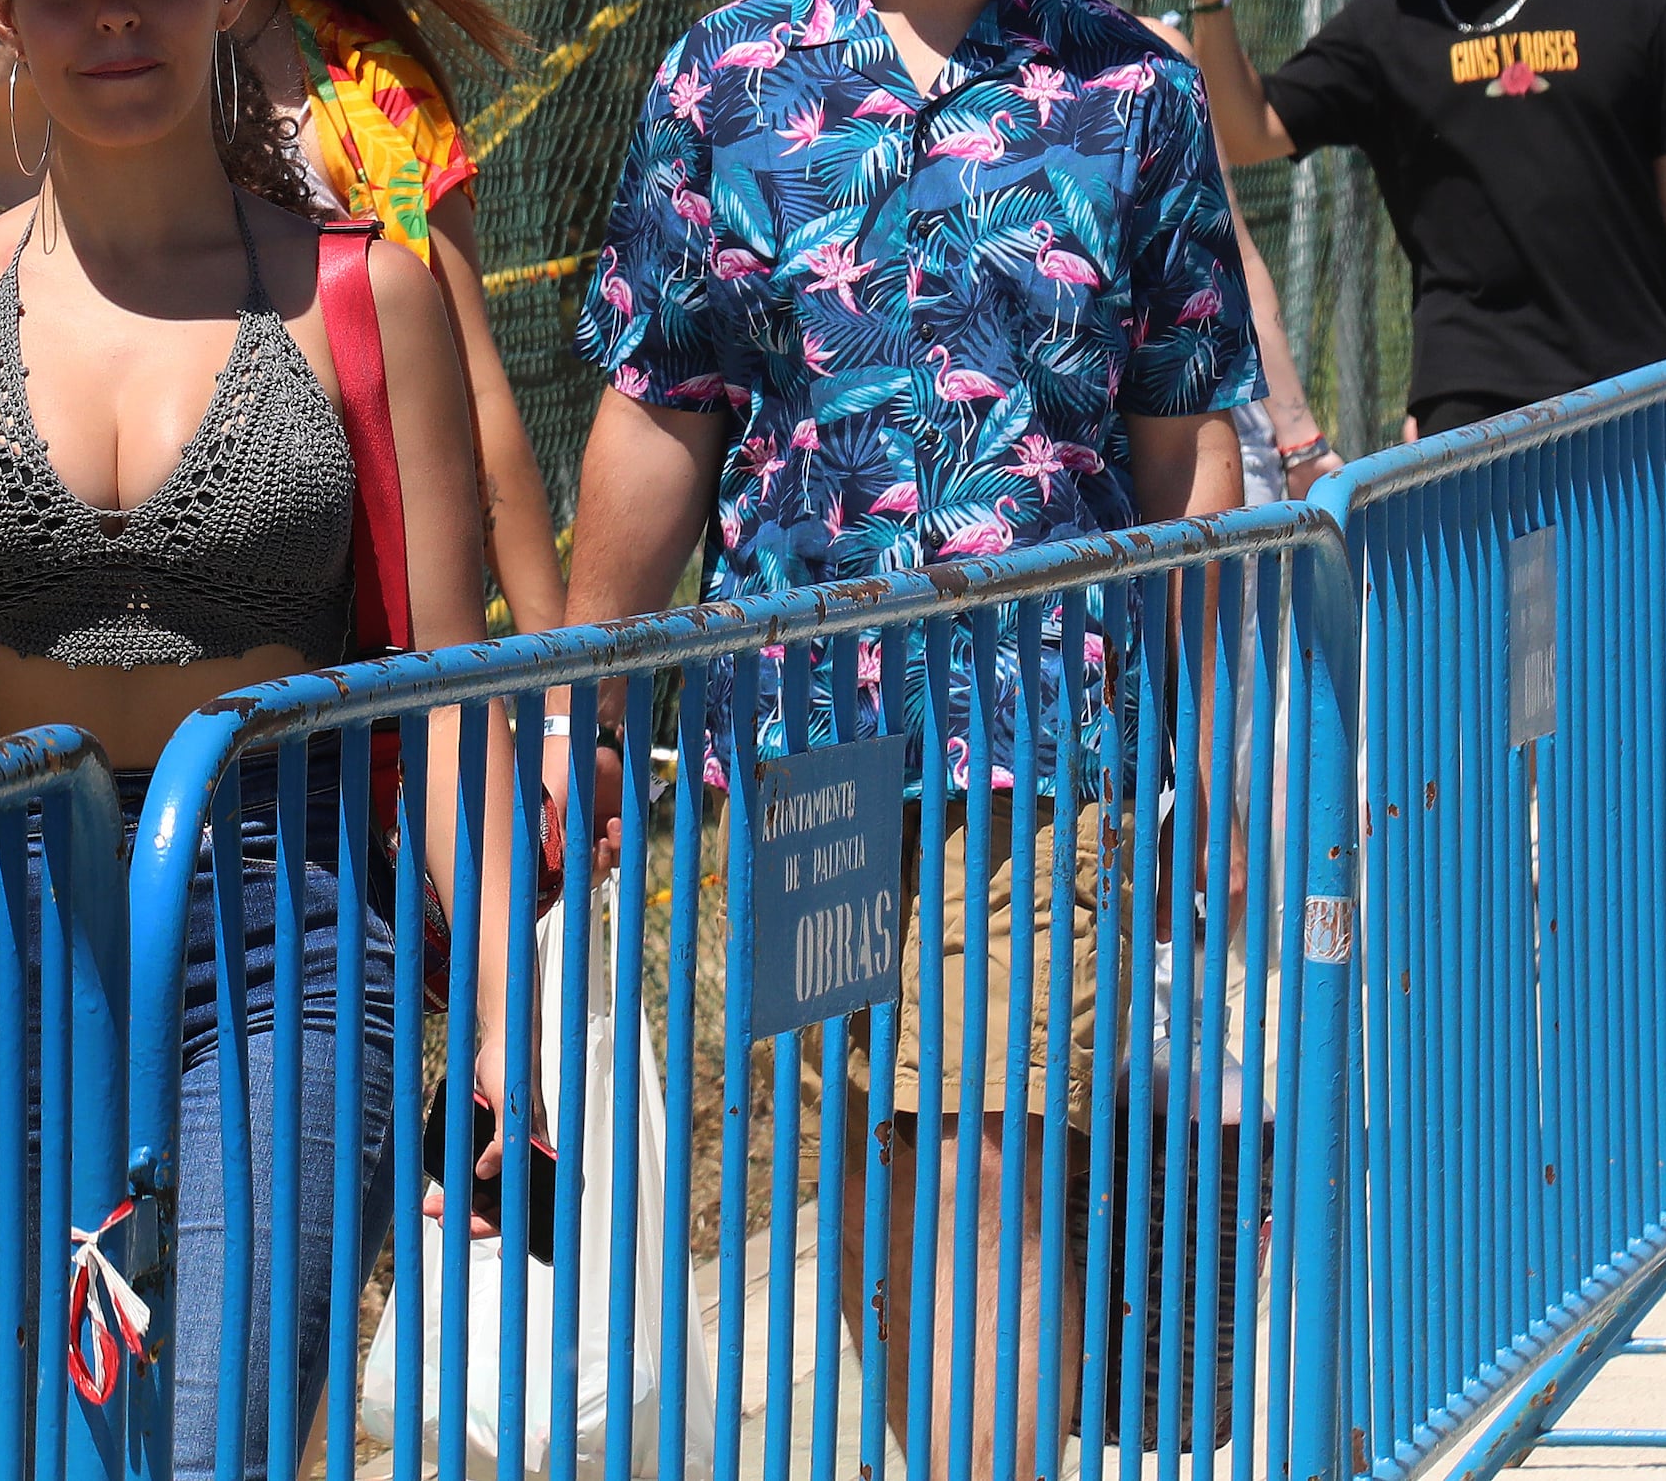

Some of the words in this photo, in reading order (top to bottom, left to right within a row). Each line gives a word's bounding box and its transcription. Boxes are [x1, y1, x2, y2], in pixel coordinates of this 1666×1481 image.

[1450, 35, 1500, 83] GUNS
[1519, 29, 1579, 73] ROSES
[762, 780, 856, 842] AYUNTAMIENTO
[785, 854, 801, 893] DE
[813, 833, 865, 885] PALENCIA
[795, 890, 892, 1002] OBRAS
